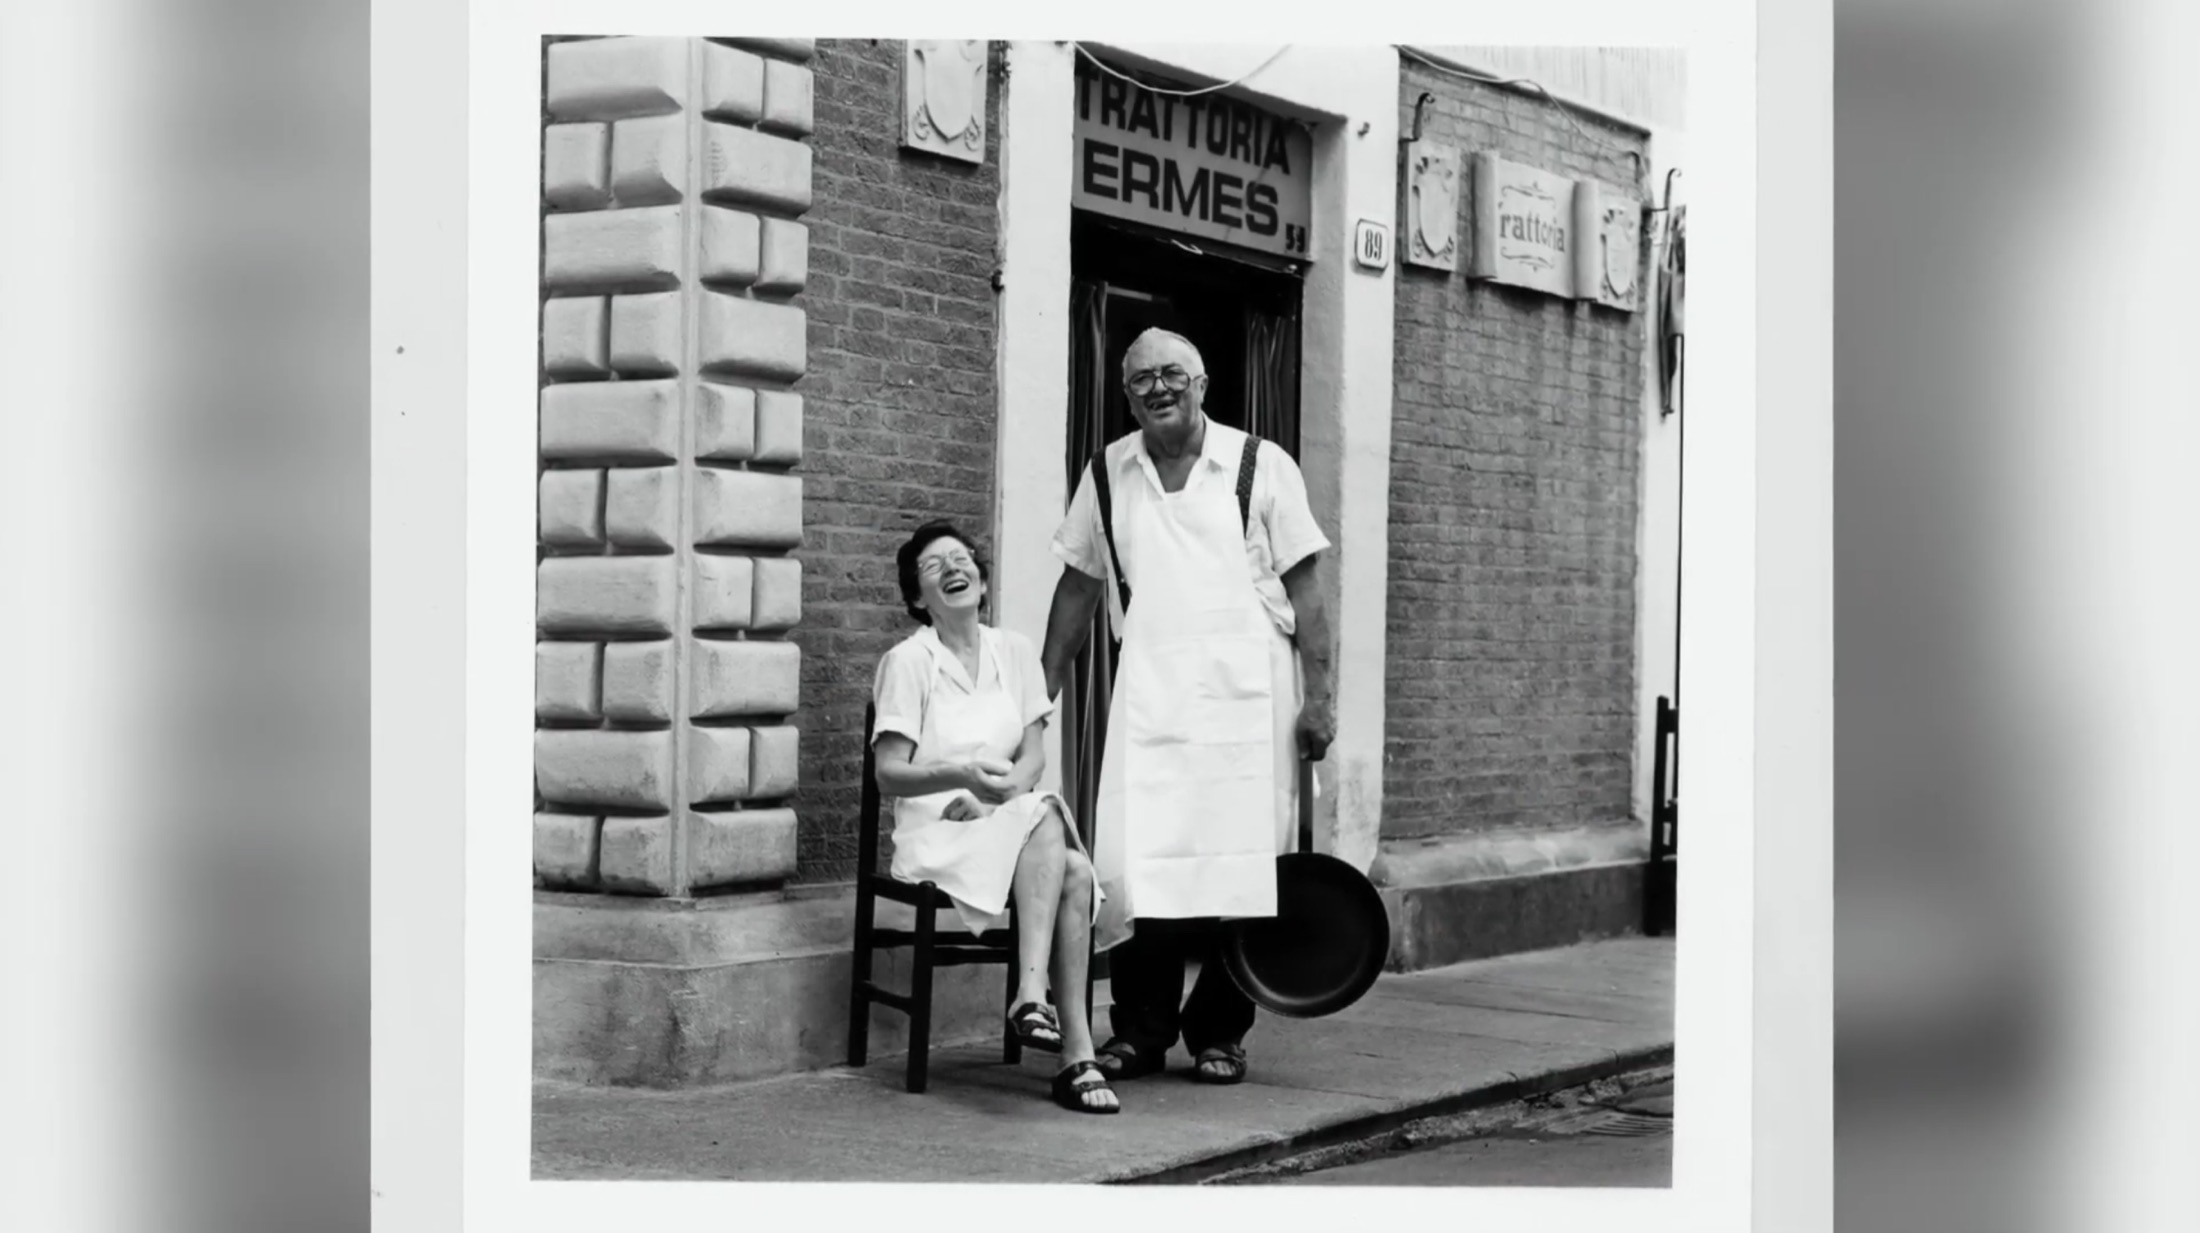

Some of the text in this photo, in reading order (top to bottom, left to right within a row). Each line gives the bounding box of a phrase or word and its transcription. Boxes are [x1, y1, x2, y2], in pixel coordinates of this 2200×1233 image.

[1075, 69, 1290, 175] TRATTORIA
[1083, 137, 1279, 237] ERMES
[1365, 228, 1382, 261] 89
